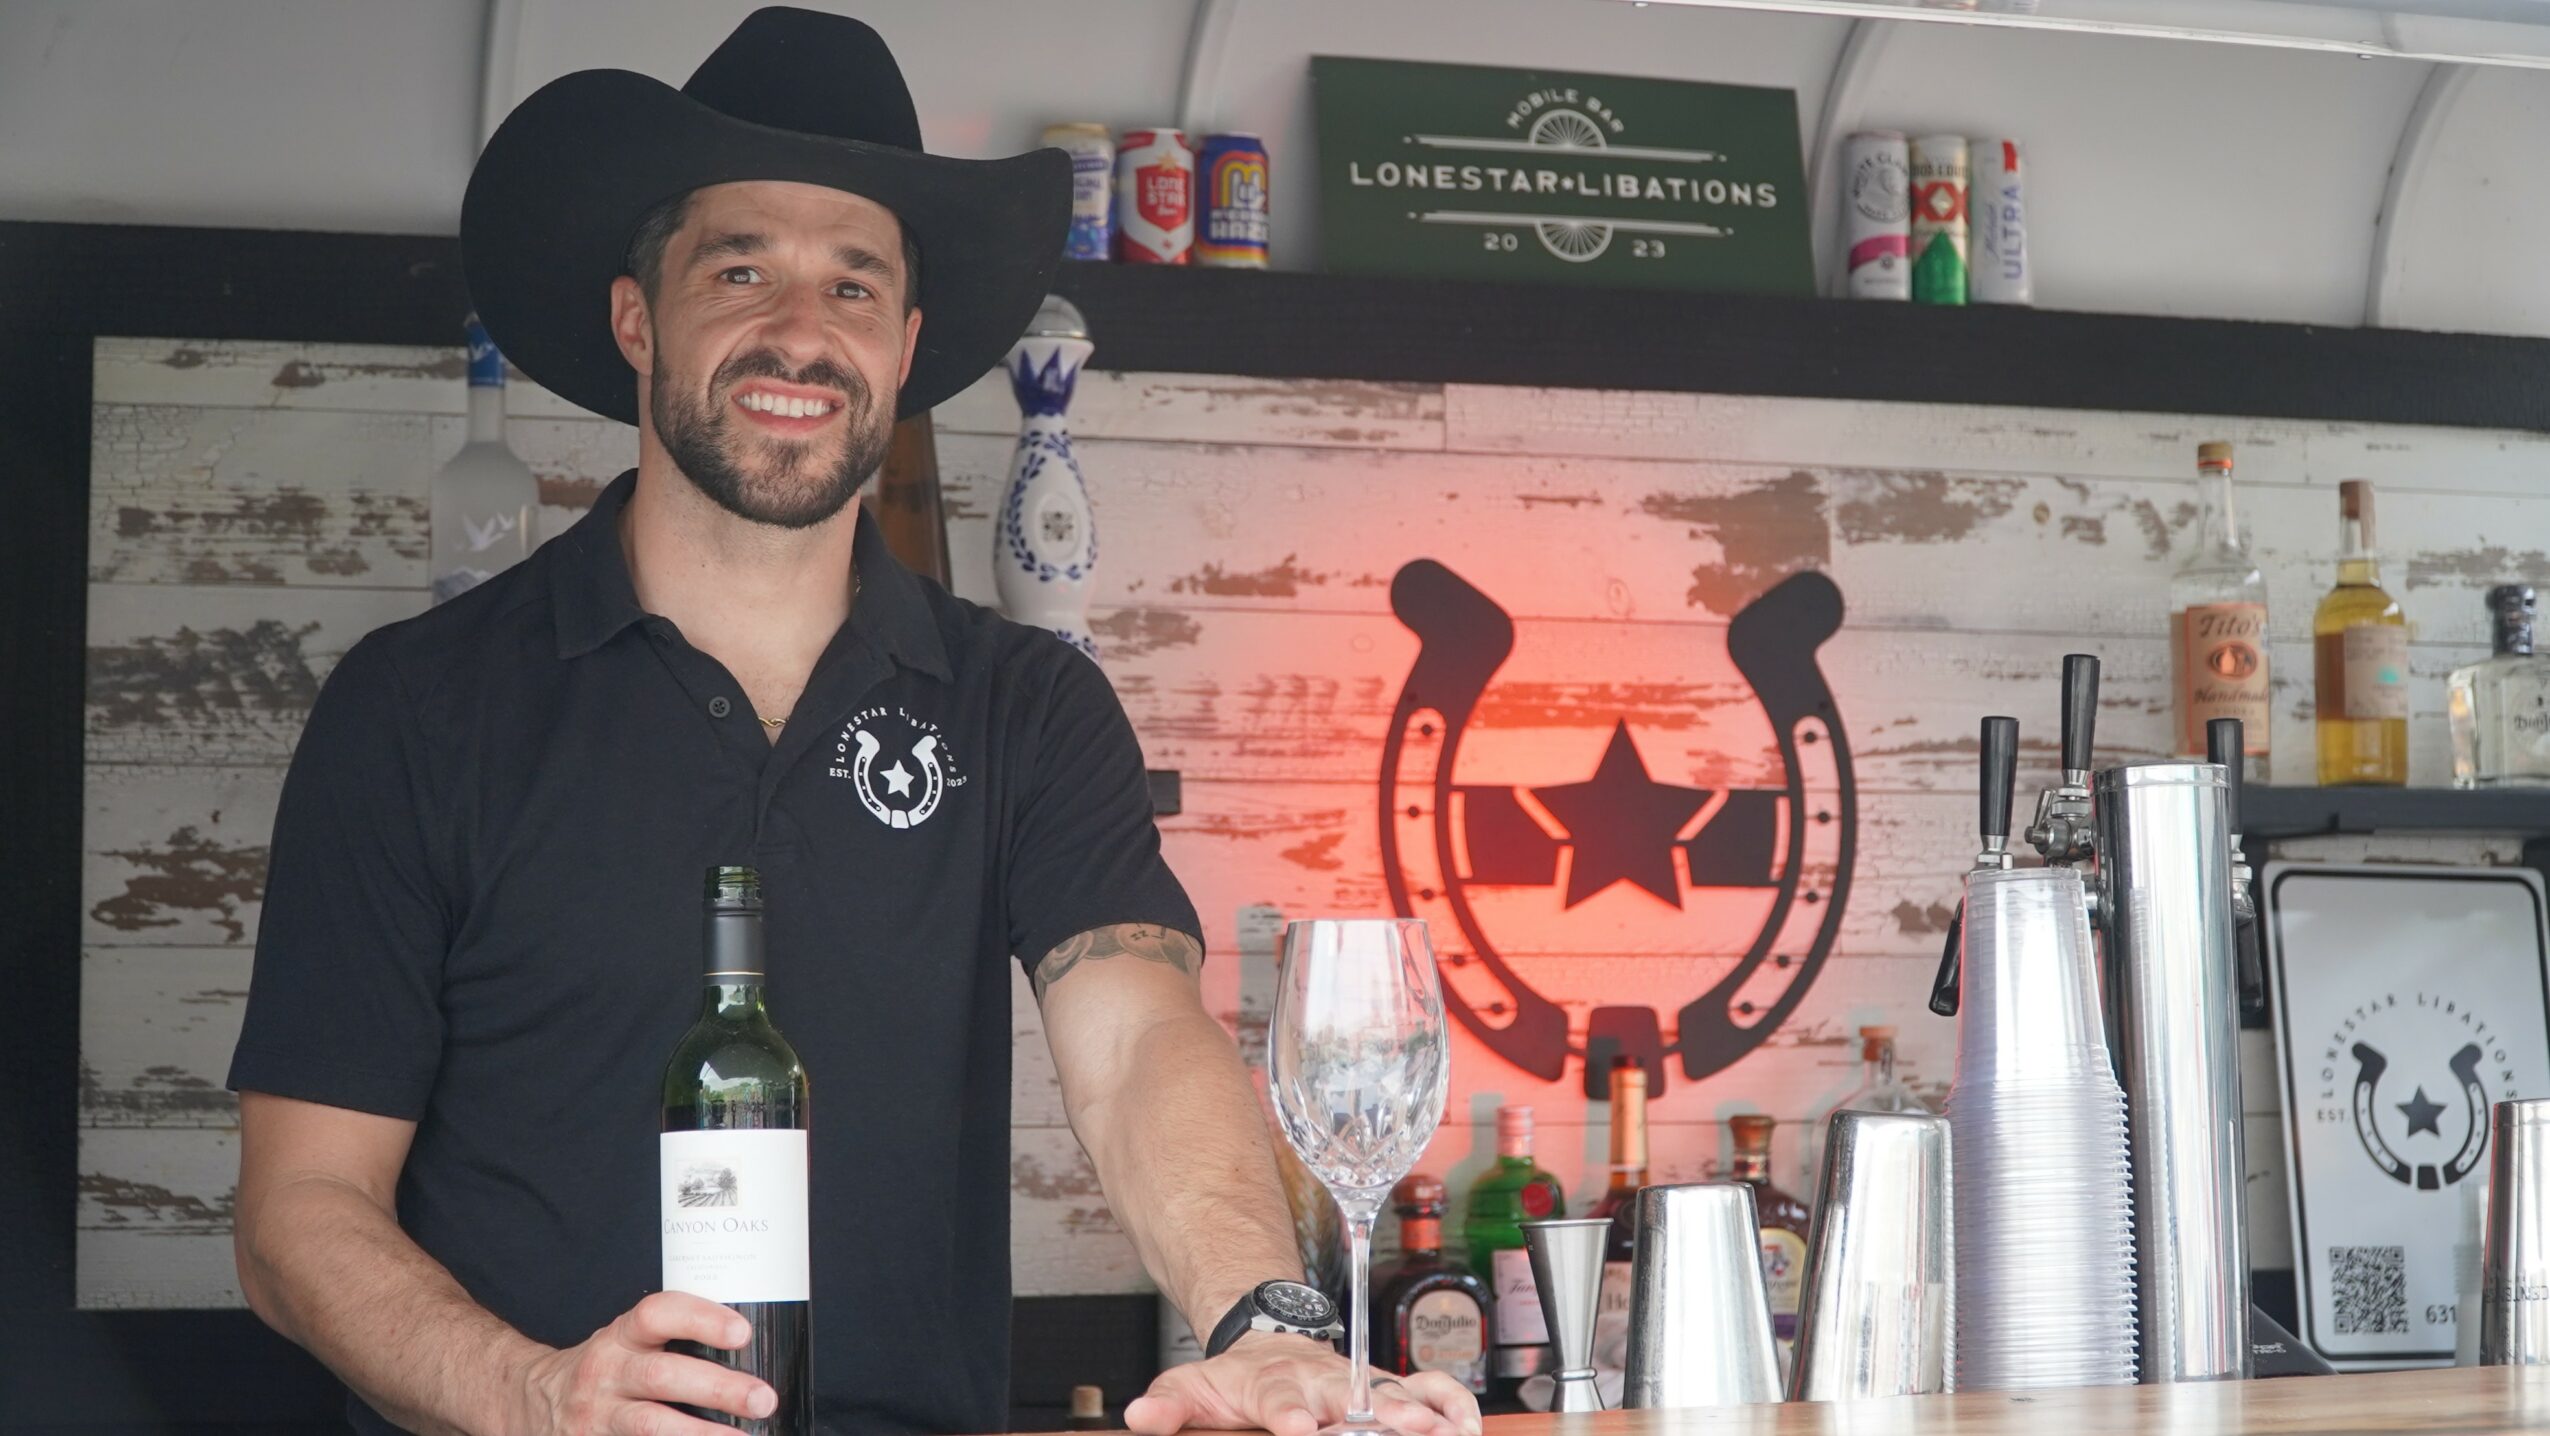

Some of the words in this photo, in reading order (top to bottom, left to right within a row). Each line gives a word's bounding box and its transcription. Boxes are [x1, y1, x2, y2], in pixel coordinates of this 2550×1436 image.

[1506, 88, 1579, 129] MOBILE
[1585, 96, 1625, 133] BAR
[1349, 161, 1558, 194] LONESTAR
[1577, 172, 1777, 208] LIBATIONS
[1483, 232, 1519, 253] 20
[1632, 239, 1666, 259] 23
[2001, 184, 2023, 280] ULTRA
[835, 706, 888, 764] LONESTAR
[899, 707, 957, 773] LIBATIONS
[829, 767, 852, 779] EST.
[2321, 993, 2397, 1098] LONESTAR
[2417, 991, 2519, 1100] LIBATIONS
[722, 1217, 769, 1233] OAKS
